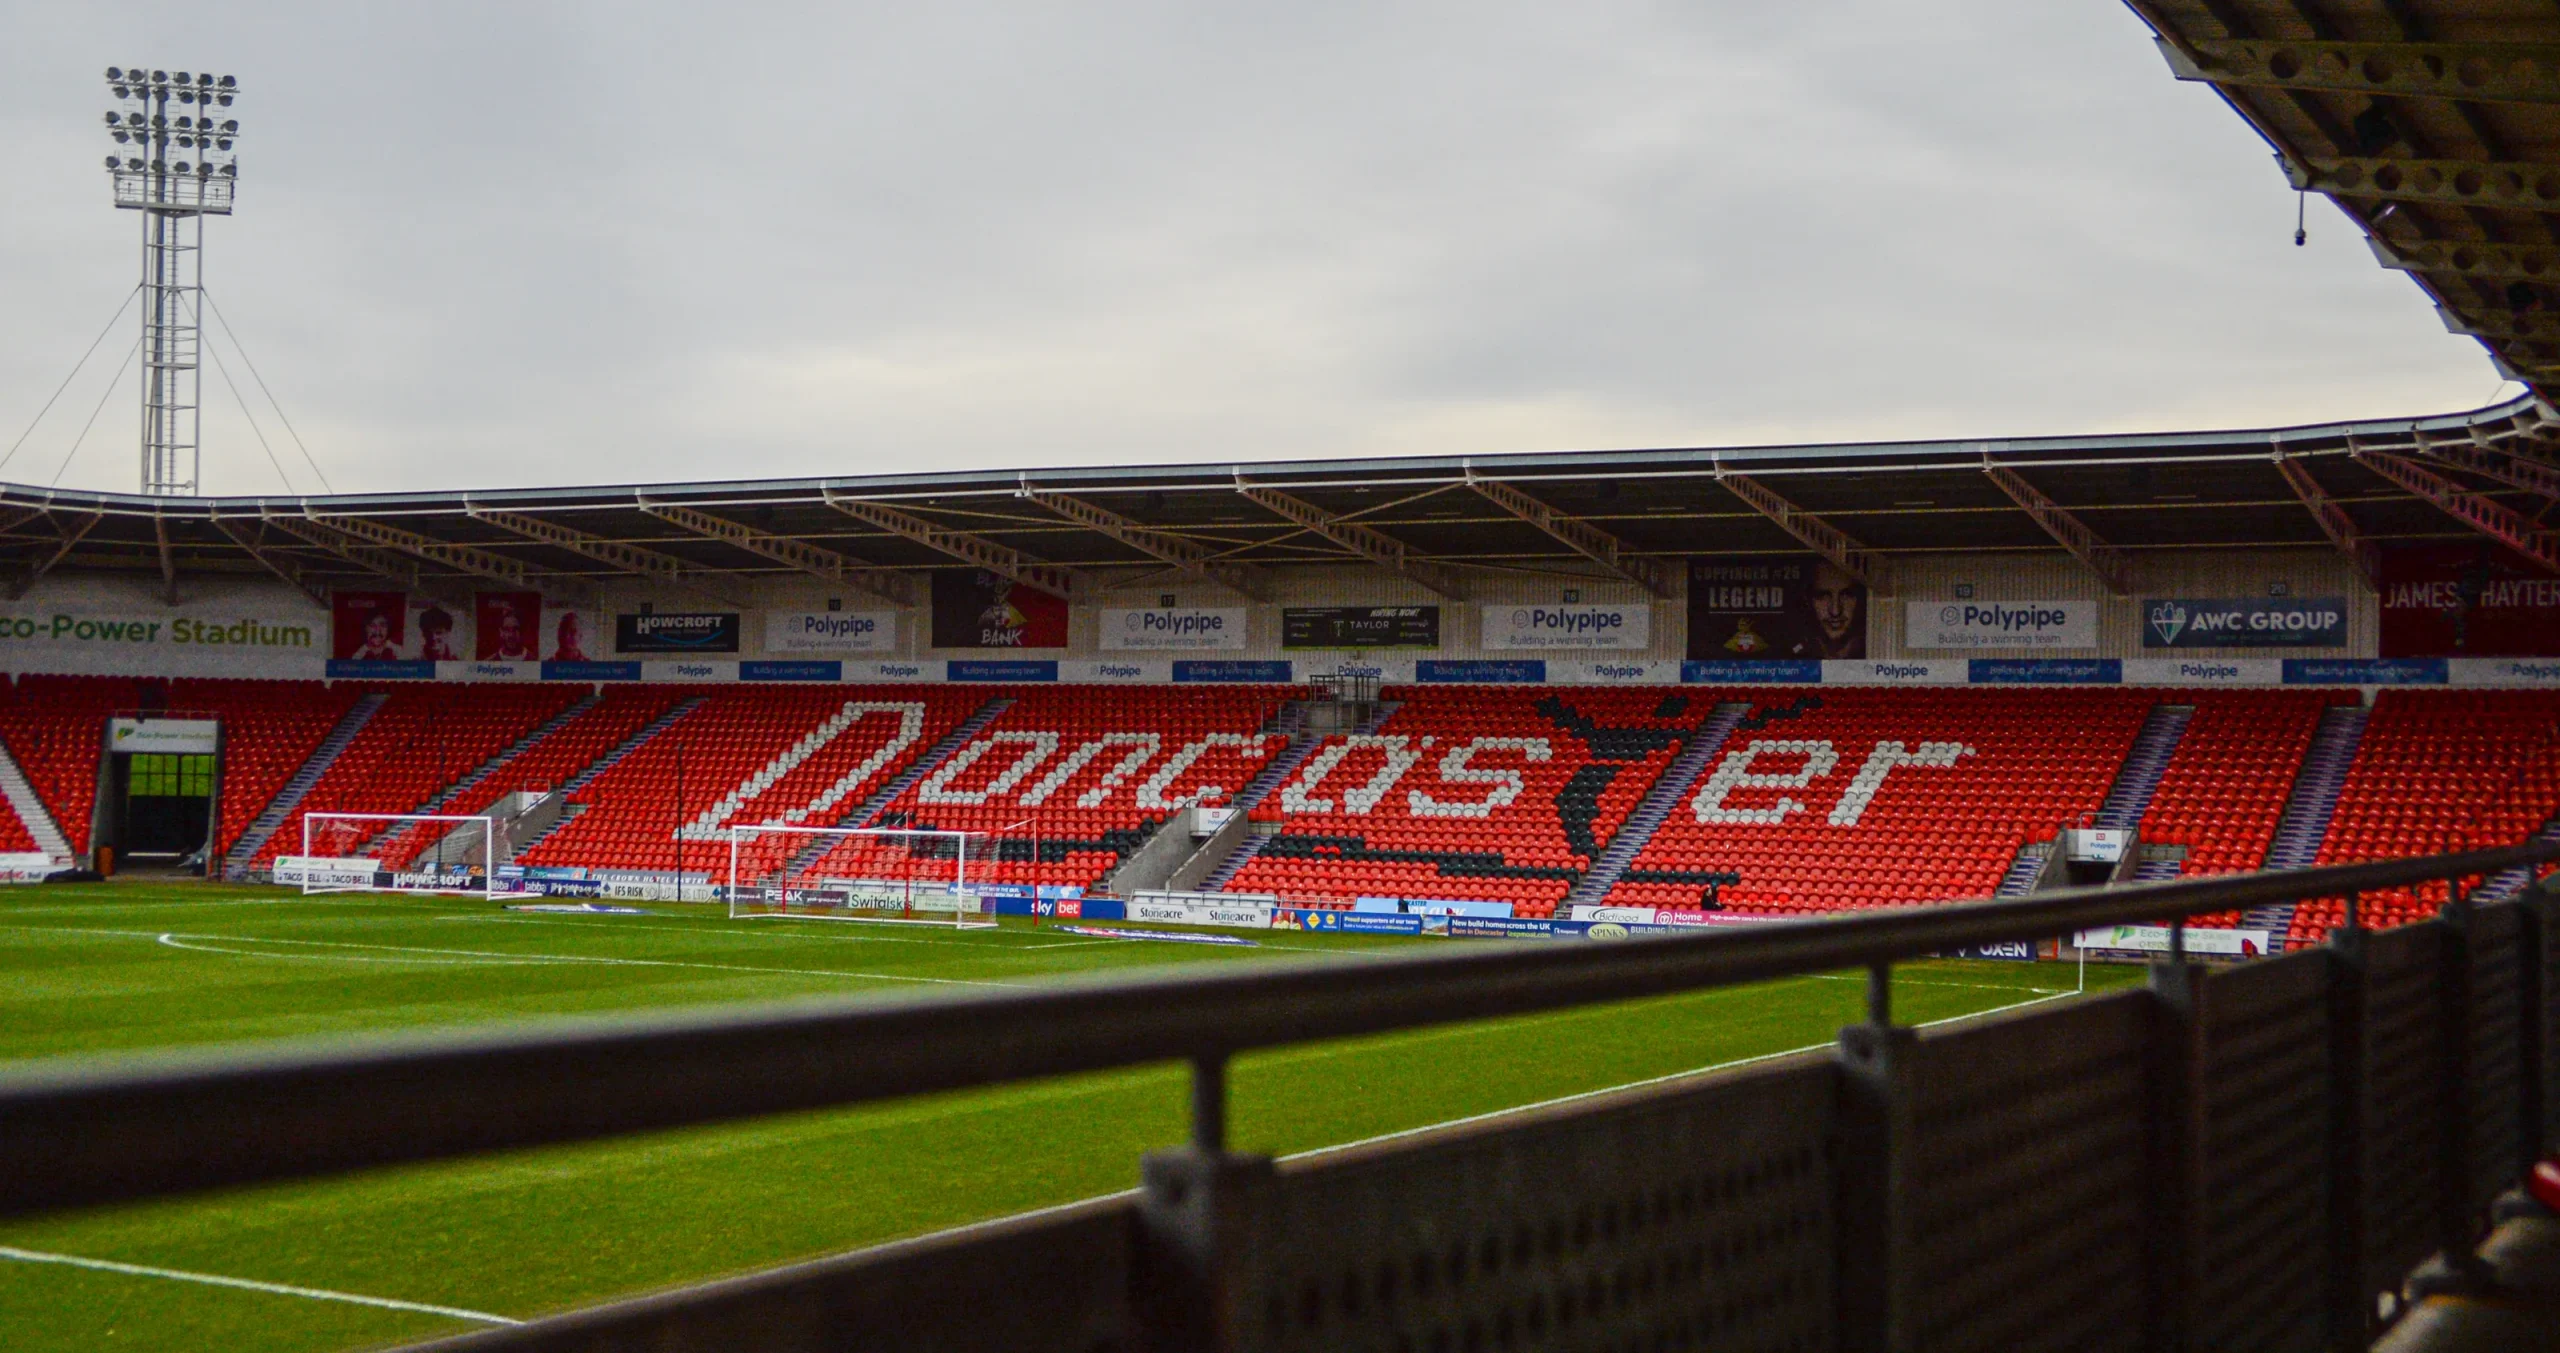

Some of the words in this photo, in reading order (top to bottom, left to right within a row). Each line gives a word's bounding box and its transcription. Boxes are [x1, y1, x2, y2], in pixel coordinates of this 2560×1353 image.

[1957, 585, 1971, 595] 19
[2271, 583, 2286, 594] 20
[2384, 581, 2459, 608] JAMES
[2480, 579, 2560, 608] HAYTER
[1163, 597, 1174, 607] 17
[1708, 587, 1784, 608] LEGEND
[1370, 608, 1396, 618] HIRING
[1398, 608, 1421, 618] NOW!
[1964, 605, 2066, 631] Polypipe
[636, 616, 723, 634] HOWCROFT
[805, 615, 875, 637] Polypipe
[1143, 612, 1222, 635] Polypipe
[1350, 620, 1390, 630] TAYLOR
[1533, 608, 1622, 633] Polypipe
[2190, 612, 2242, 631] AWC
[2250, 611, 2339, 631] GROUP
[171, 618, 313, 648] Stadium
[980, 628, 1024, 645] BANK
[1510, 636, 1546, 646] Building
[1556, 638, 1592, 647] winning
[1938, 634, 1978, 645] Building
[1991, 635, 2032, 645] winning
[2035, 636, 2061, 644] team
[477, 664, 514, 677] Polypipe
[677, 665, 713, 677] Polypipe
[880, 665, 919, 677] Polypipe
[1100, 664, 1141, 677] Polypipe
[1595, 664, 1644, 678] Polypipe
[1700, 666, 1733, 678] Building
[1742, 667, 1777, 678] winning
[1778, 667, 1799, 676] team
[1875, 663, 1928, 678] Polypipe
[2180, 664, 2239, 679] Polypipe
[283, 872, 302, 882] TACO
[305, 873, 320, 883] ELL
[331, 875, 351, 885] TACO
[352, 876, 372, 885] BELL
[591, 873, 609, 881] THE
[610, 873, 640, 882] CROWN
[614, 885, 626, 897] IFS
[627, 886, 644, 897] RISK
[693, 888, 708, 900] LTD
[765, 889, 803, 902] PEAK
[1058, 902, 1079, 914] bet
[1140, 906, 1183, 920] Stoneacre
[1209, 909, 1256, 922] Stoneacre
[1600, 911, 1639, 922] Bidfood
[1674, 912, 1703, 922] Home
[1452, 919, 1467, 927] New
[1468, 920, 1484, 928] build
[1485, 920, 1506, 929] homes
[1527, 922, 1538, 930] the
[1539, 922, 1551, 931] UK
[1630, 925, 1666, 935] BUILDING
[1452, 927, 1466, 936] Born
[1467, 928, 1474, 936] in
[1474, 929, 1505, 937] Doncaster
[1591, 928, 1625, 938] SPINKS
